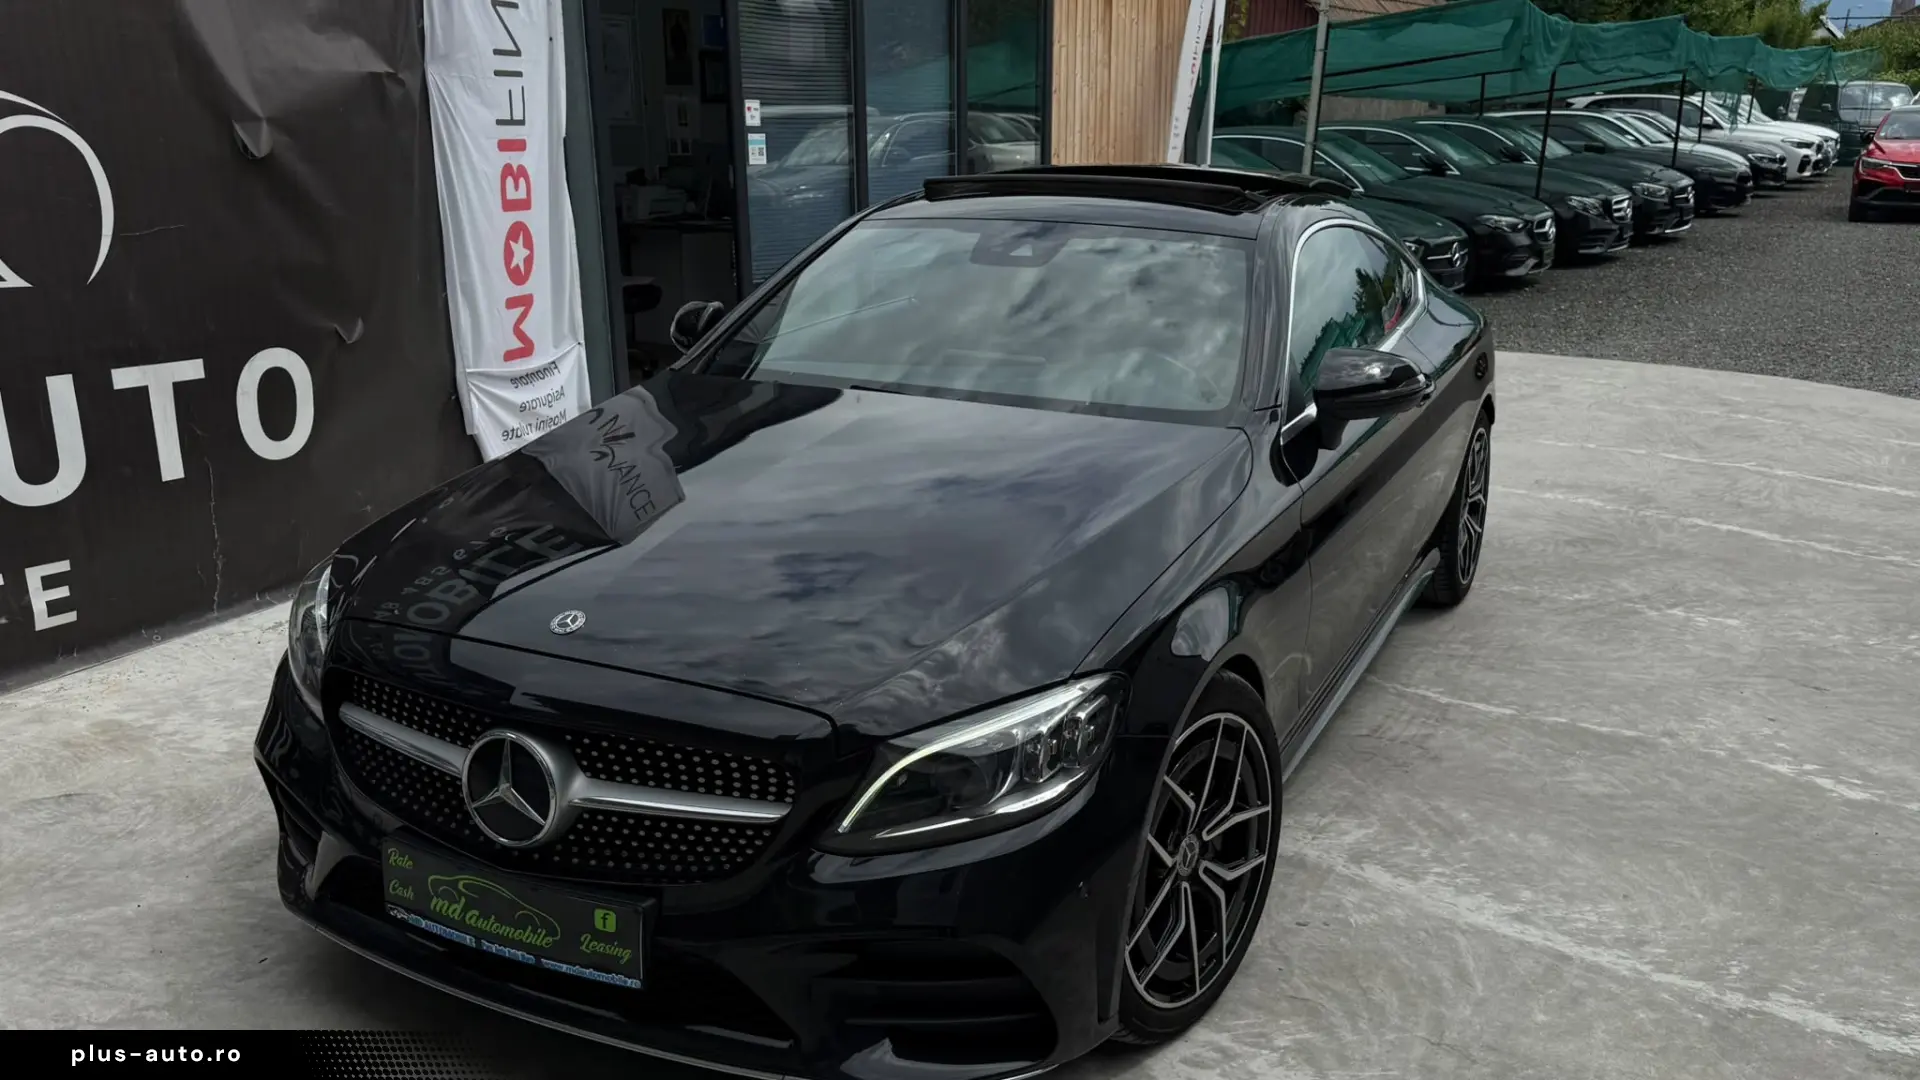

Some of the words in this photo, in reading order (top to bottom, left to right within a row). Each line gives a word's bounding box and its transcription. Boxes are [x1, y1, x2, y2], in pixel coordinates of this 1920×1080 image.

[0, 347, 315, 507] UTO
[0, 559, 78, 631] E
[388, 848, 413, 869] Rate
[389, 879, 415, 900] Cash
[580, 933, 631, 964] Leasing
